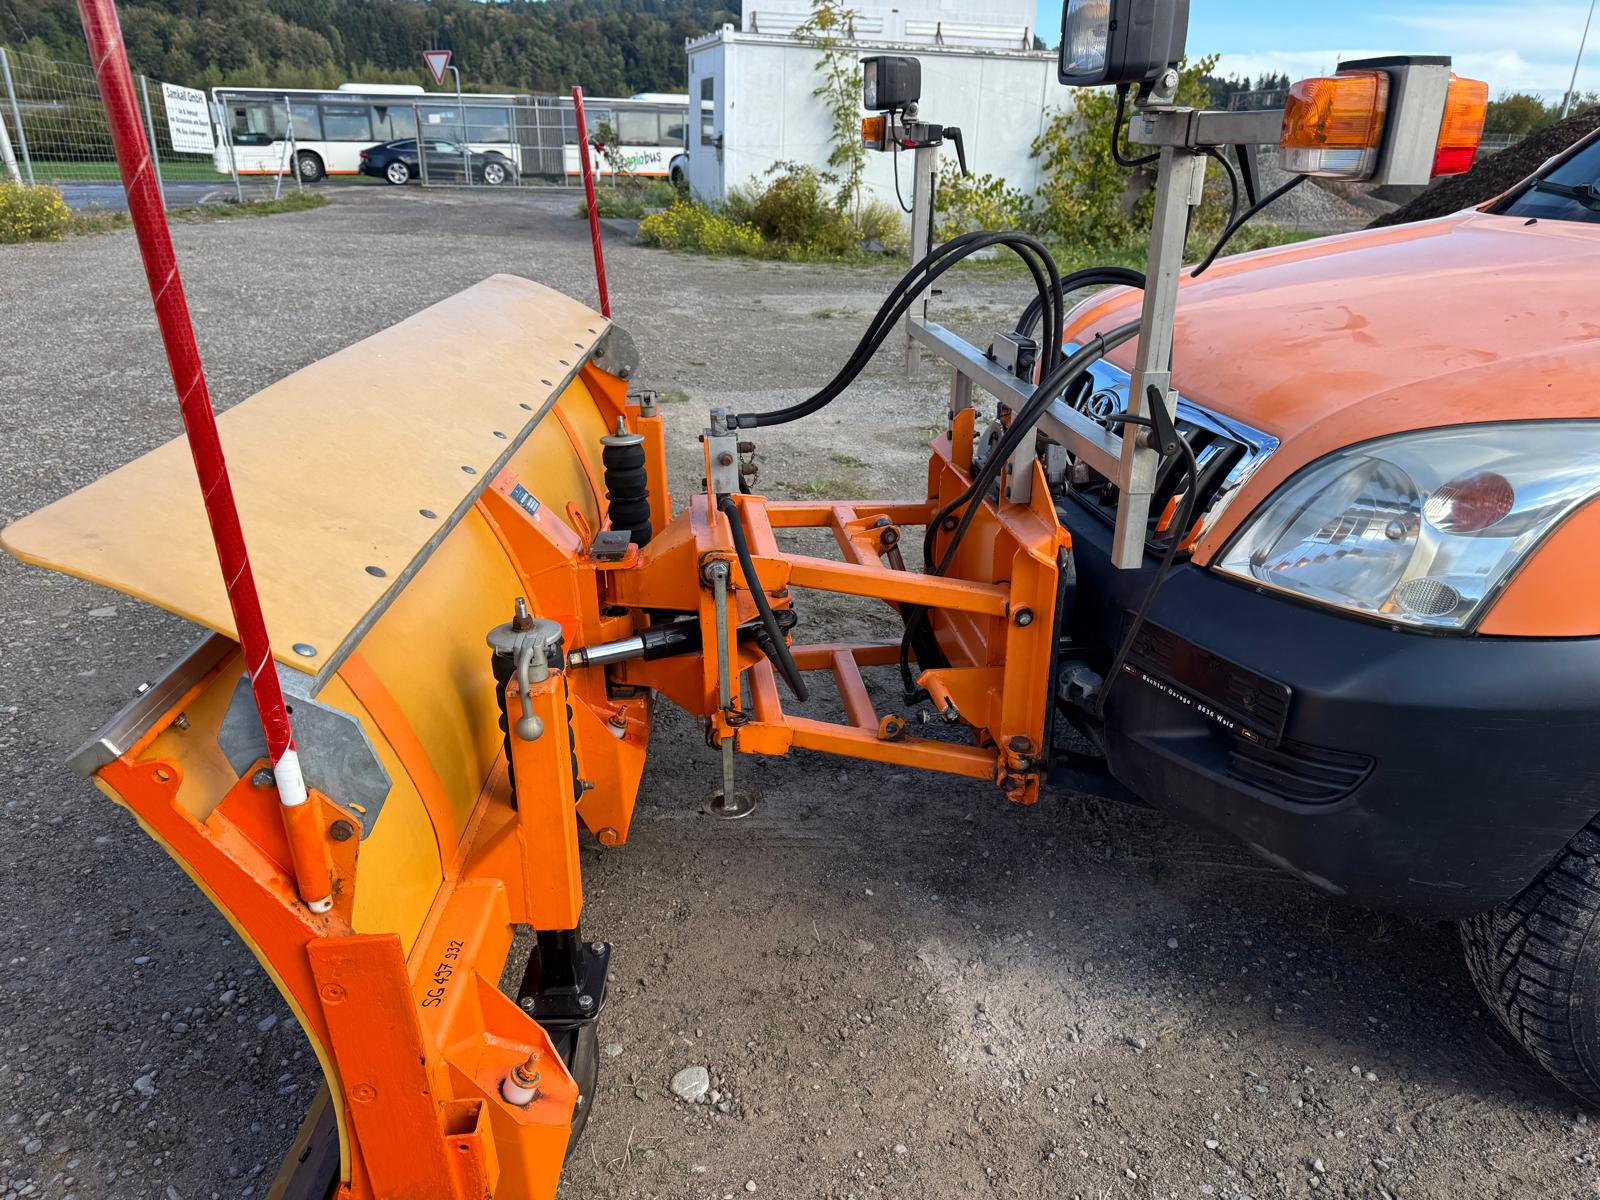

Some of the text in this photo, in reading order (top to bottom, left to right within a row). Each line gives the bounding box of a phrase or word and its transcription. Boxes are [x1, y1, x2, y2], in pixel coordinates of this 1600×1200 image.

[1168, 688, 1191, 705] Garage
[1216, 714, 1234, 729] Wald
[421, 940, 464, 1008] SG 497 932
